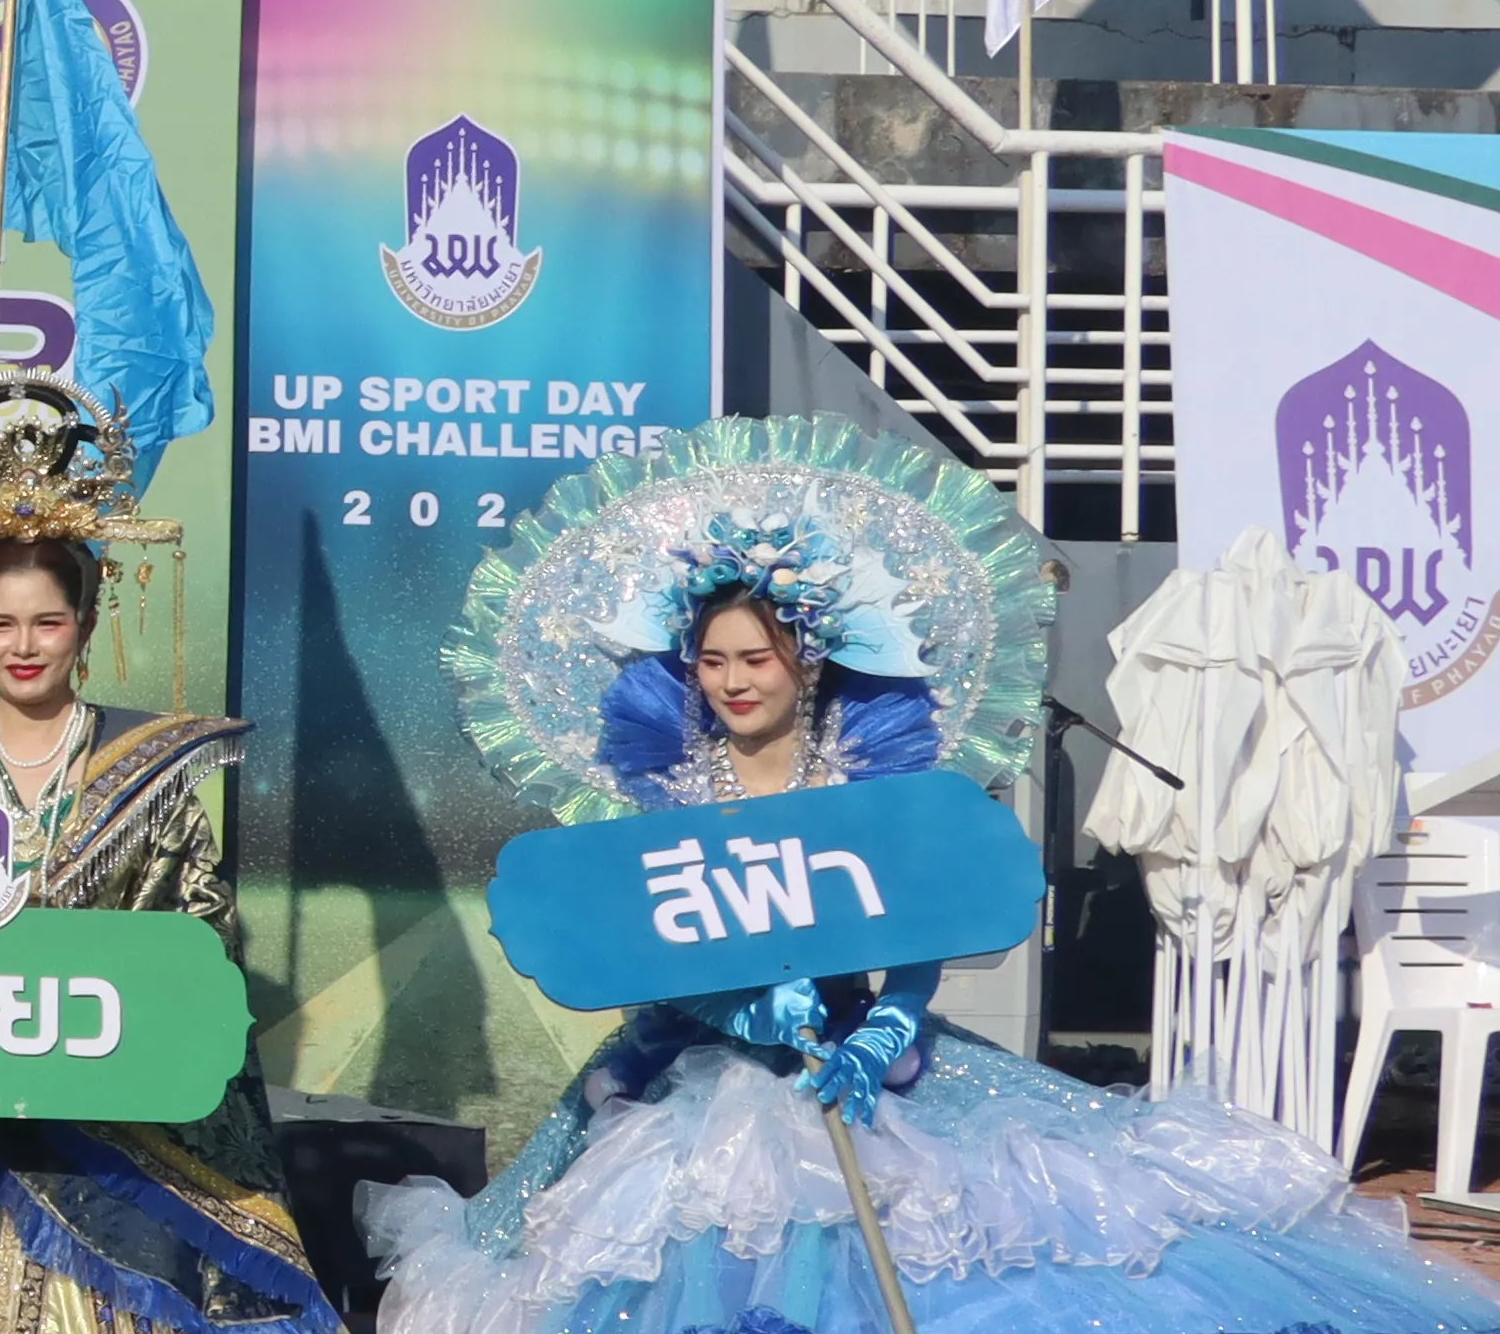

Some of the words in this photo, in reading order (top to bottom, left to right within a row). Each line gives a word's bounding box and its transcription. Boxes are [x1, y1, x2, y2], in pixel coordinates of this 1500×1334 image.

[273, 374, 343, 411] UP
[359, 376, 531, 415] SPORT
[547, 380, 646, 417] DAY
[248, 417, 341, 454] BMI
[641, 837, 886, 944] สีฟ้า
